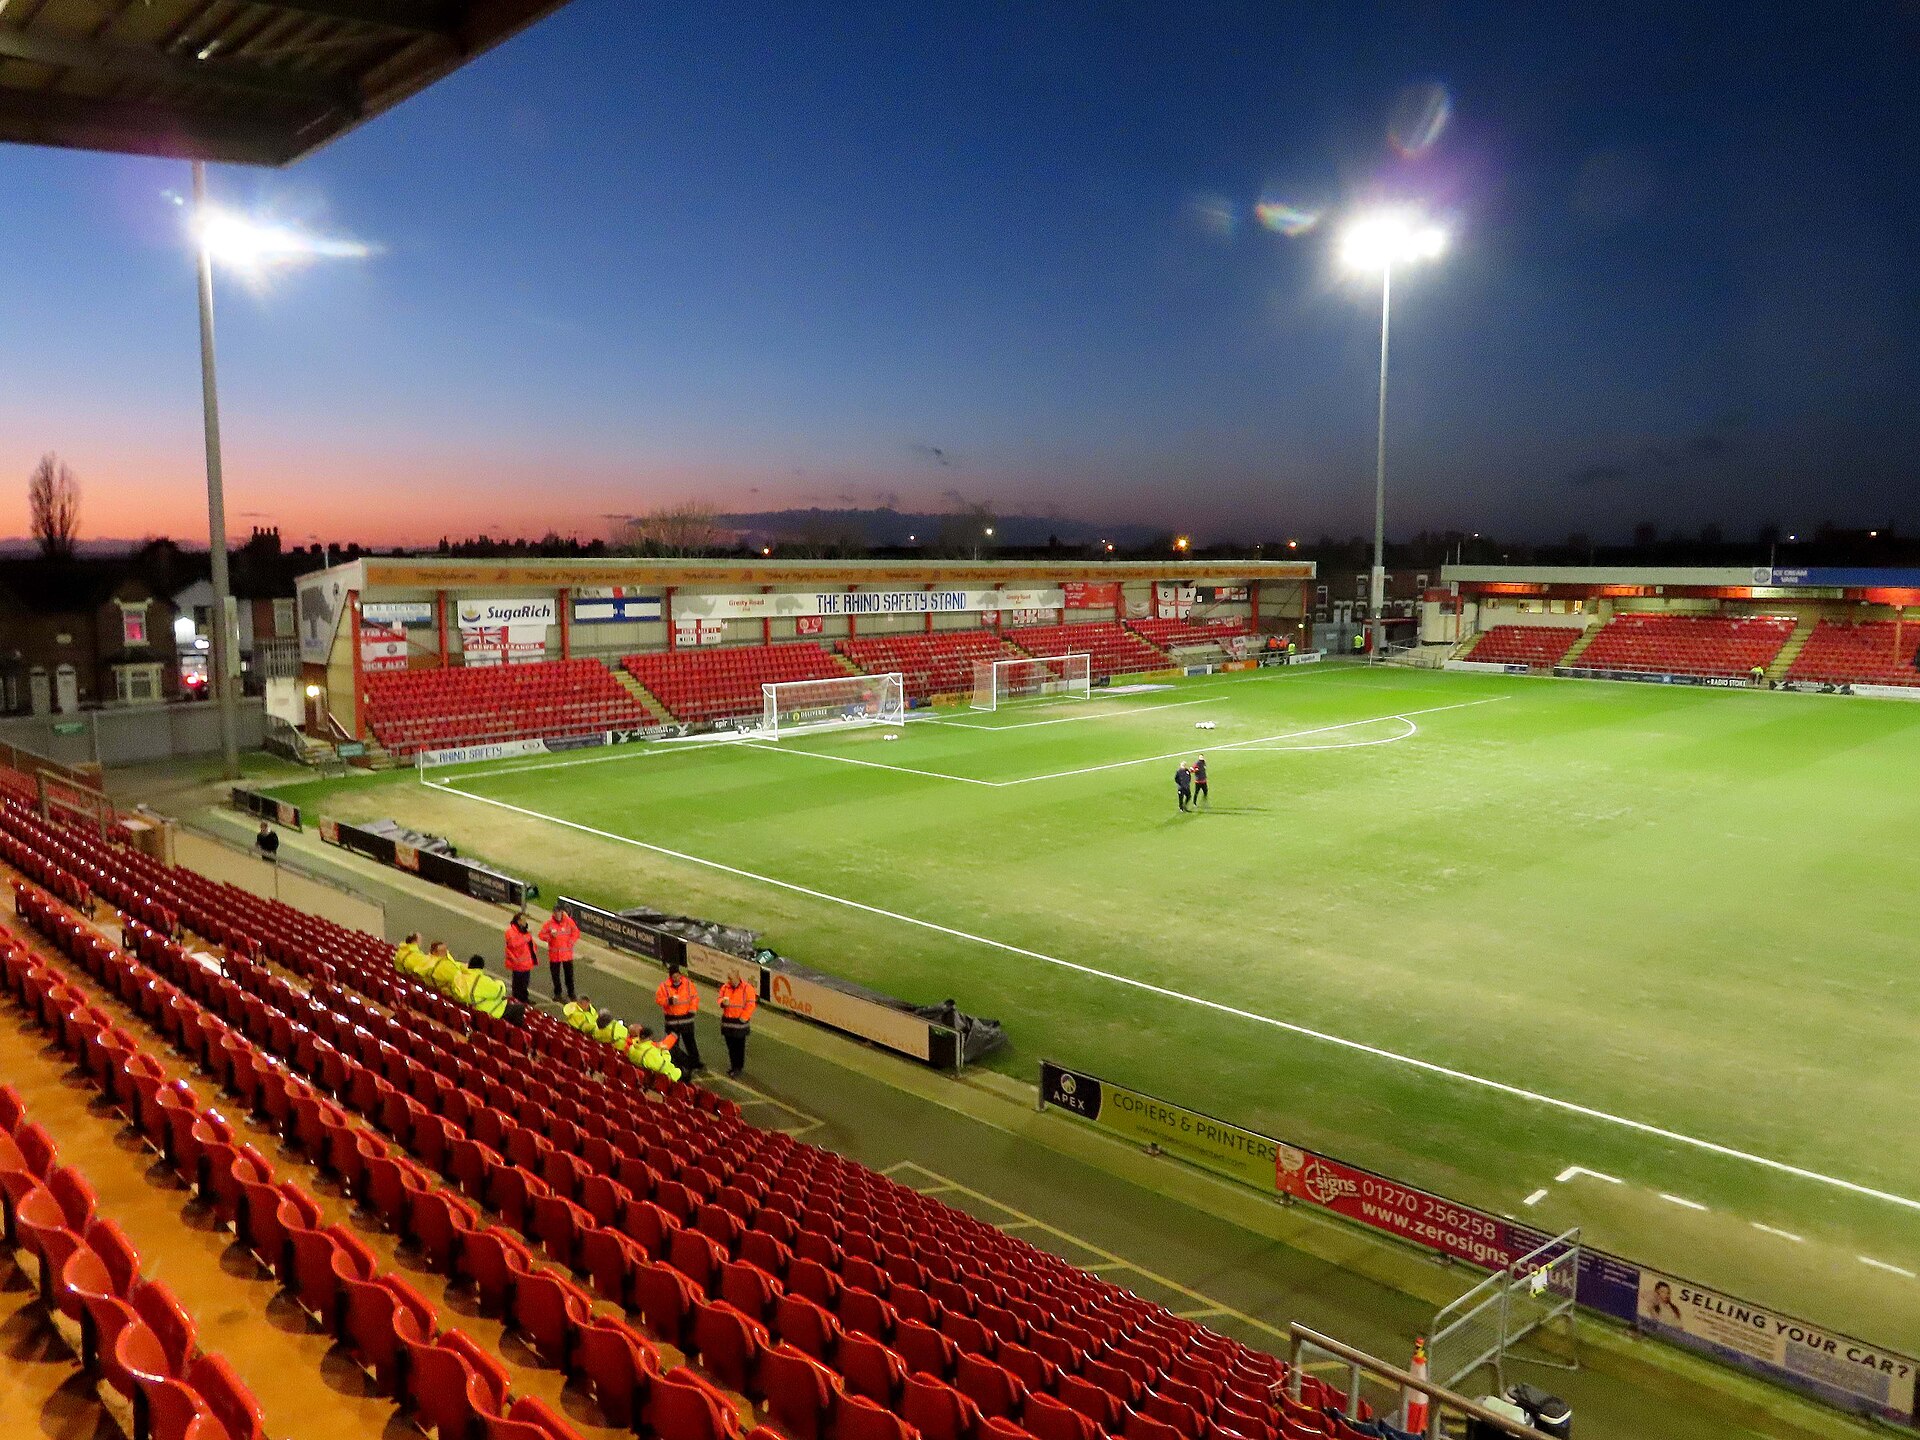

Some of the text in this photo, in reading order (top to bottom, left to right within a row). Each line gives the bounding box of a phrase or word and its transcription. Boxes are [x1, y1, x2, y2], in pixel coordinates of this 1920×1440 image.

[486, 604, 551, 622] SugaRich
[815, 592, 966, 613] THE RHINO SAFETY STAND
[1710, 678, 1728, 687] RADIO
[439, 746, 502, 763] RHINO SAFETY
[782, 994, 814, 1015] ROAR
[1053, 1089, 1085, 1111] APEX
[1112, 1092, 1276, 1163] COPIERS & PRINTERS
[1315, 1173, 1357, 1196] signs
[1362, 1180, 1417, 1212] 01270
[1423, 1200, 1497, 1241] 256258
[1679, 1288, 1766, 1329] SELLING
[1776, 1321, 1837, 1355] YOUR
[1845, 1347, 1909, 1379] CAR?
